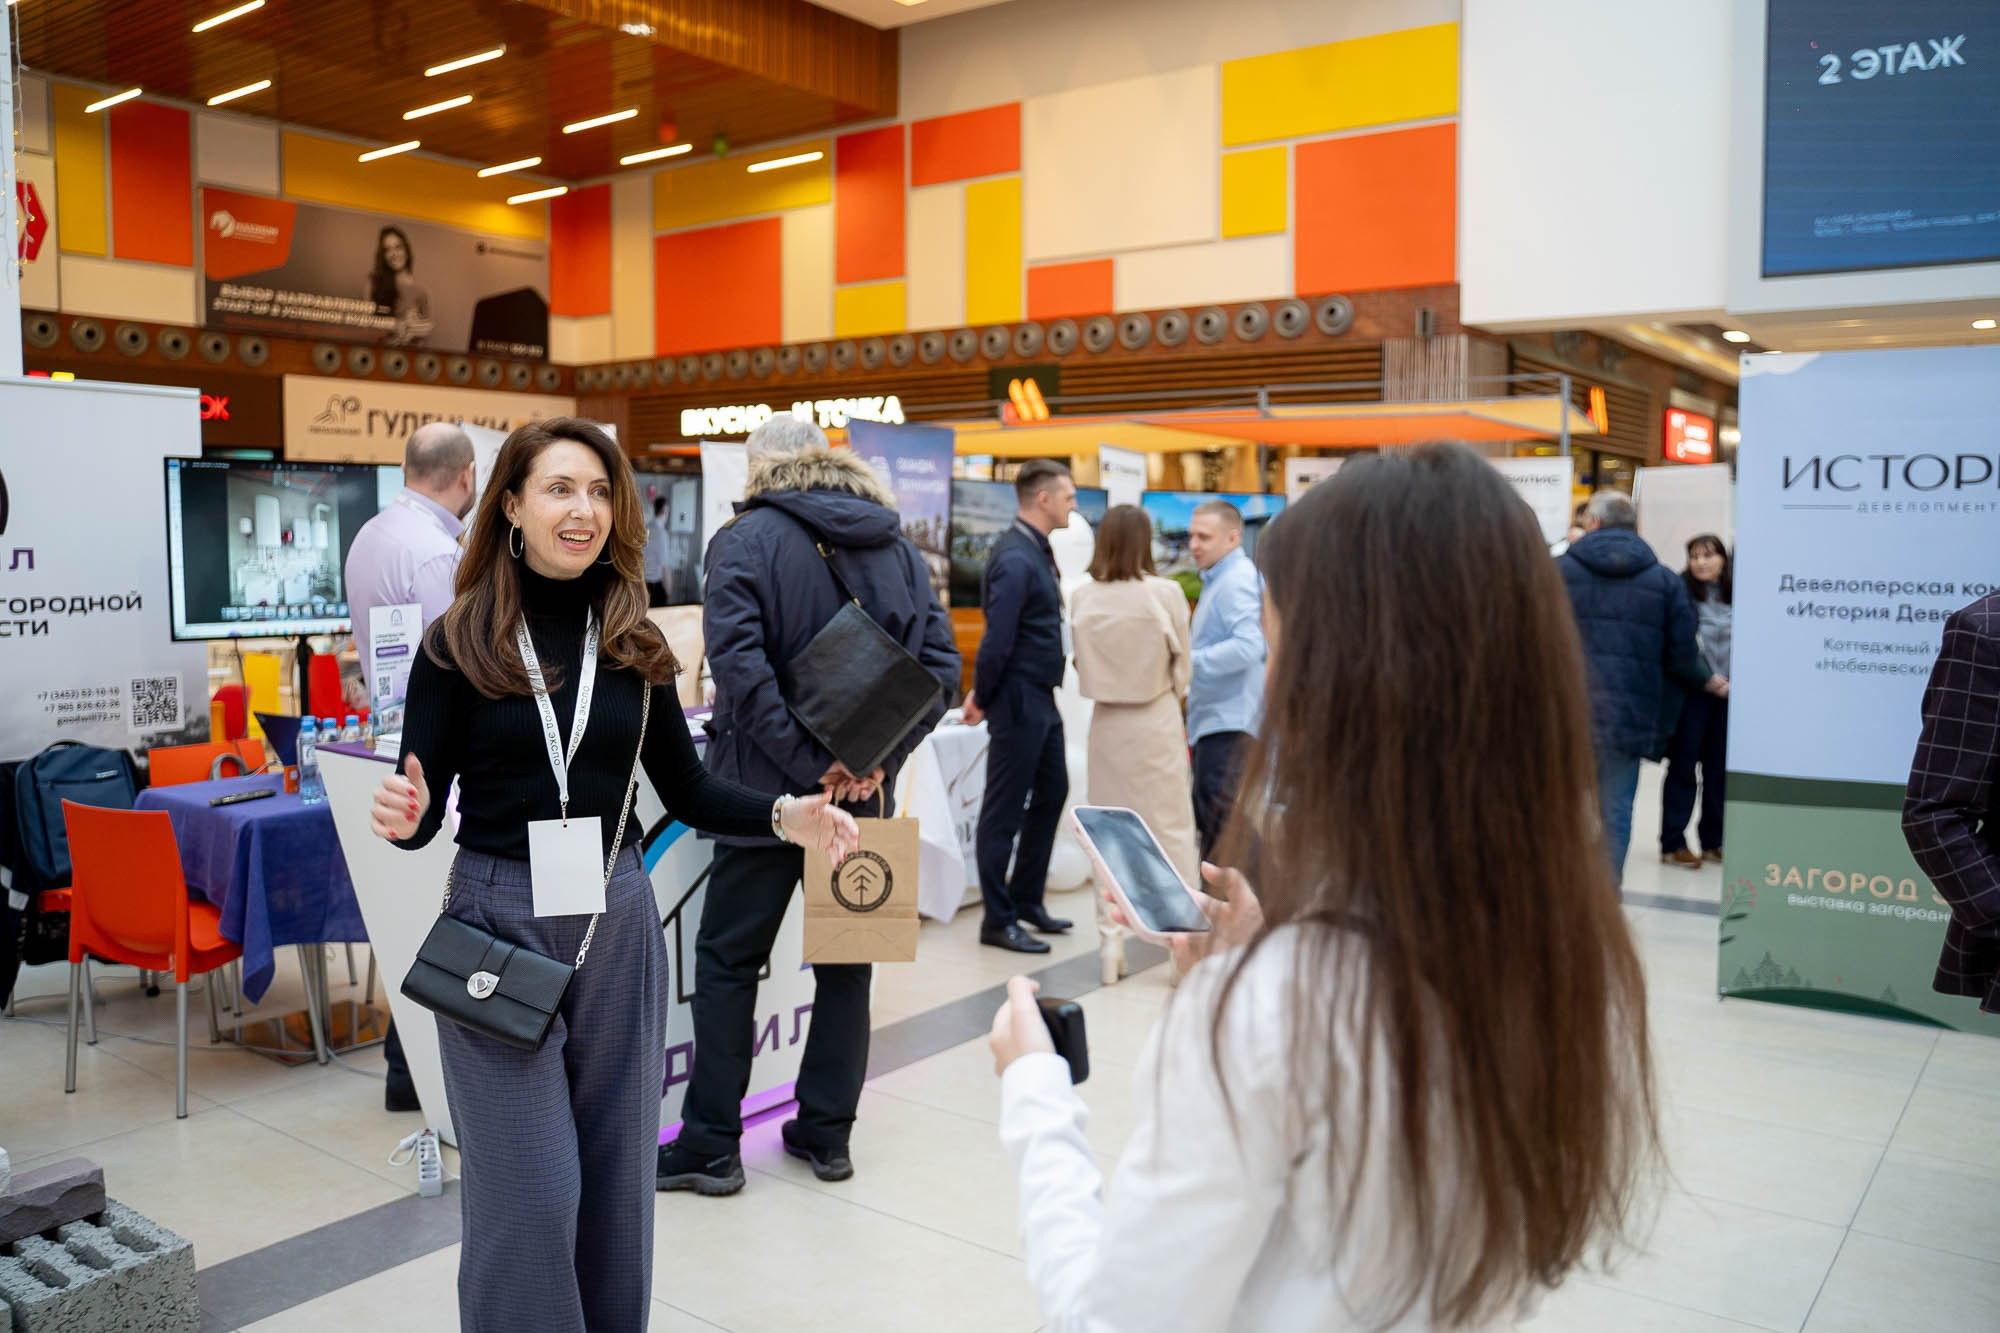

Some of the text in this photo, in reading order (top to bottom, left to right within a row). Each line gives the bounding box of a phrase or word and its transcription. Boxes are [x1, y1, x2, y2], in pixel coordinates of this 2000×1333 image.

[1818, 34, 1967, 85] 2 ЭТАЖ
[681, 403, 772, 436] ВКУСНО
[814, 395, 905, 428] ТОЧКА
[1782, 453, 2000, 491] ИСТОР
[1856, 500, 1997, 514] ДЕВЕЛОПМЕНТ
[1778, 573, 1954, 597] Девелоперская
[0, 589, 142, 615] ОРОДНОЙ
[1786, 600, 1890, 623] «История
[1823, 637, 1929, 656] Коттеджный
[579, 685, 590, 717] ЭКСПО
[548, 732, 561, 767] ЭКСПО
[1764, 863, 1919, 902] ЗАГОРОД
[1787, 893, 1866, 914] выставка
